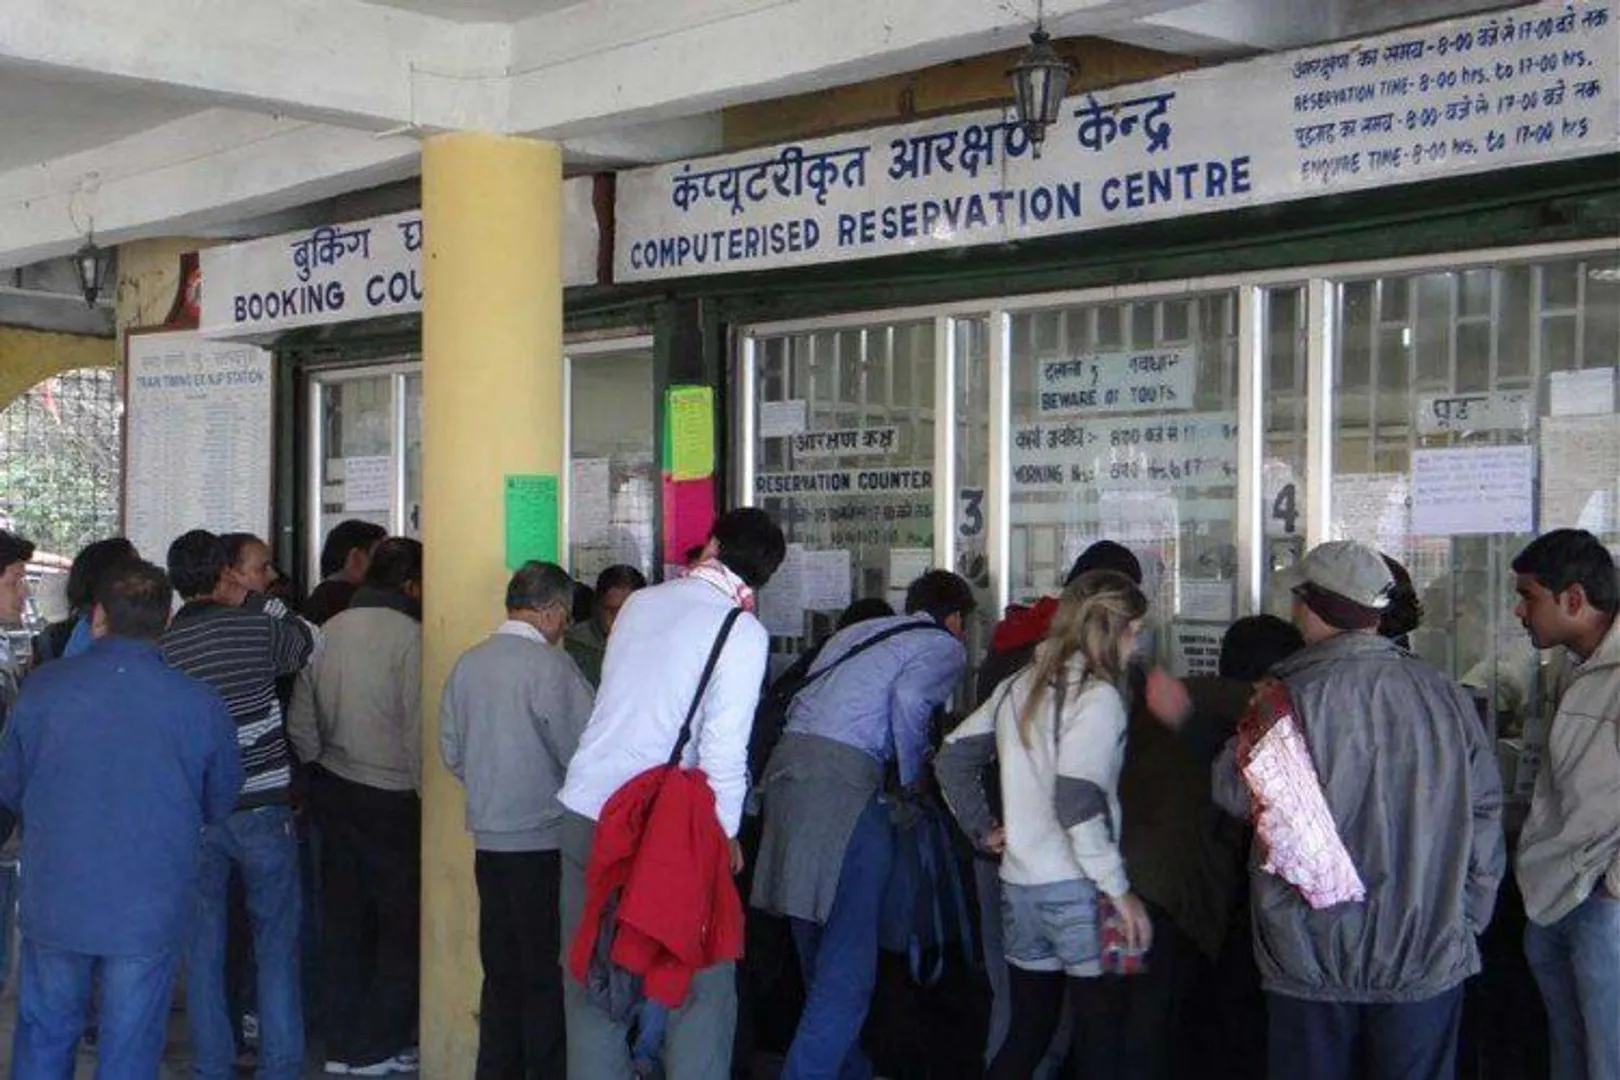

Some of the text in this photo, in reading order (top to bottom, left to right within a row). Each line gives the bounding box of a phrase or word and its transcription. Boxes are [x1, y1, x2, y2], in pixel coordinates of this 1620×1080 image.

[1293, 83, 1374, 111] RESERVATION
[1419, 70, 1457, 92] 8-00
[1495, 61, 1513, 80] to
[1518, 53, 1557, 75] 17-00
[1357, 48, 1379, 67] का
[1339, 119, 1357, 137] का
[1486, 129, 1505, 152] to
[1515, 120, 1554, 144] 17-00
[672, 145, 871, 216] कंप्यूटरीकृत
[1072, 91, 1176, 153] केन्द्र
[630, 154, 1251, 270] COMPUTERISED RESERVATION CENTRE
[290, 219, 422, 282] बुकिंग घ
[234, 269, 422, 323] BOOKING COU
[1041, 388, 1097, 411] BEWARE
[756, 469, 933, 494] RESERVATION COUNTER
[959, 488, 984, 537] 3
[1273, 483, 1300, 534] 4
